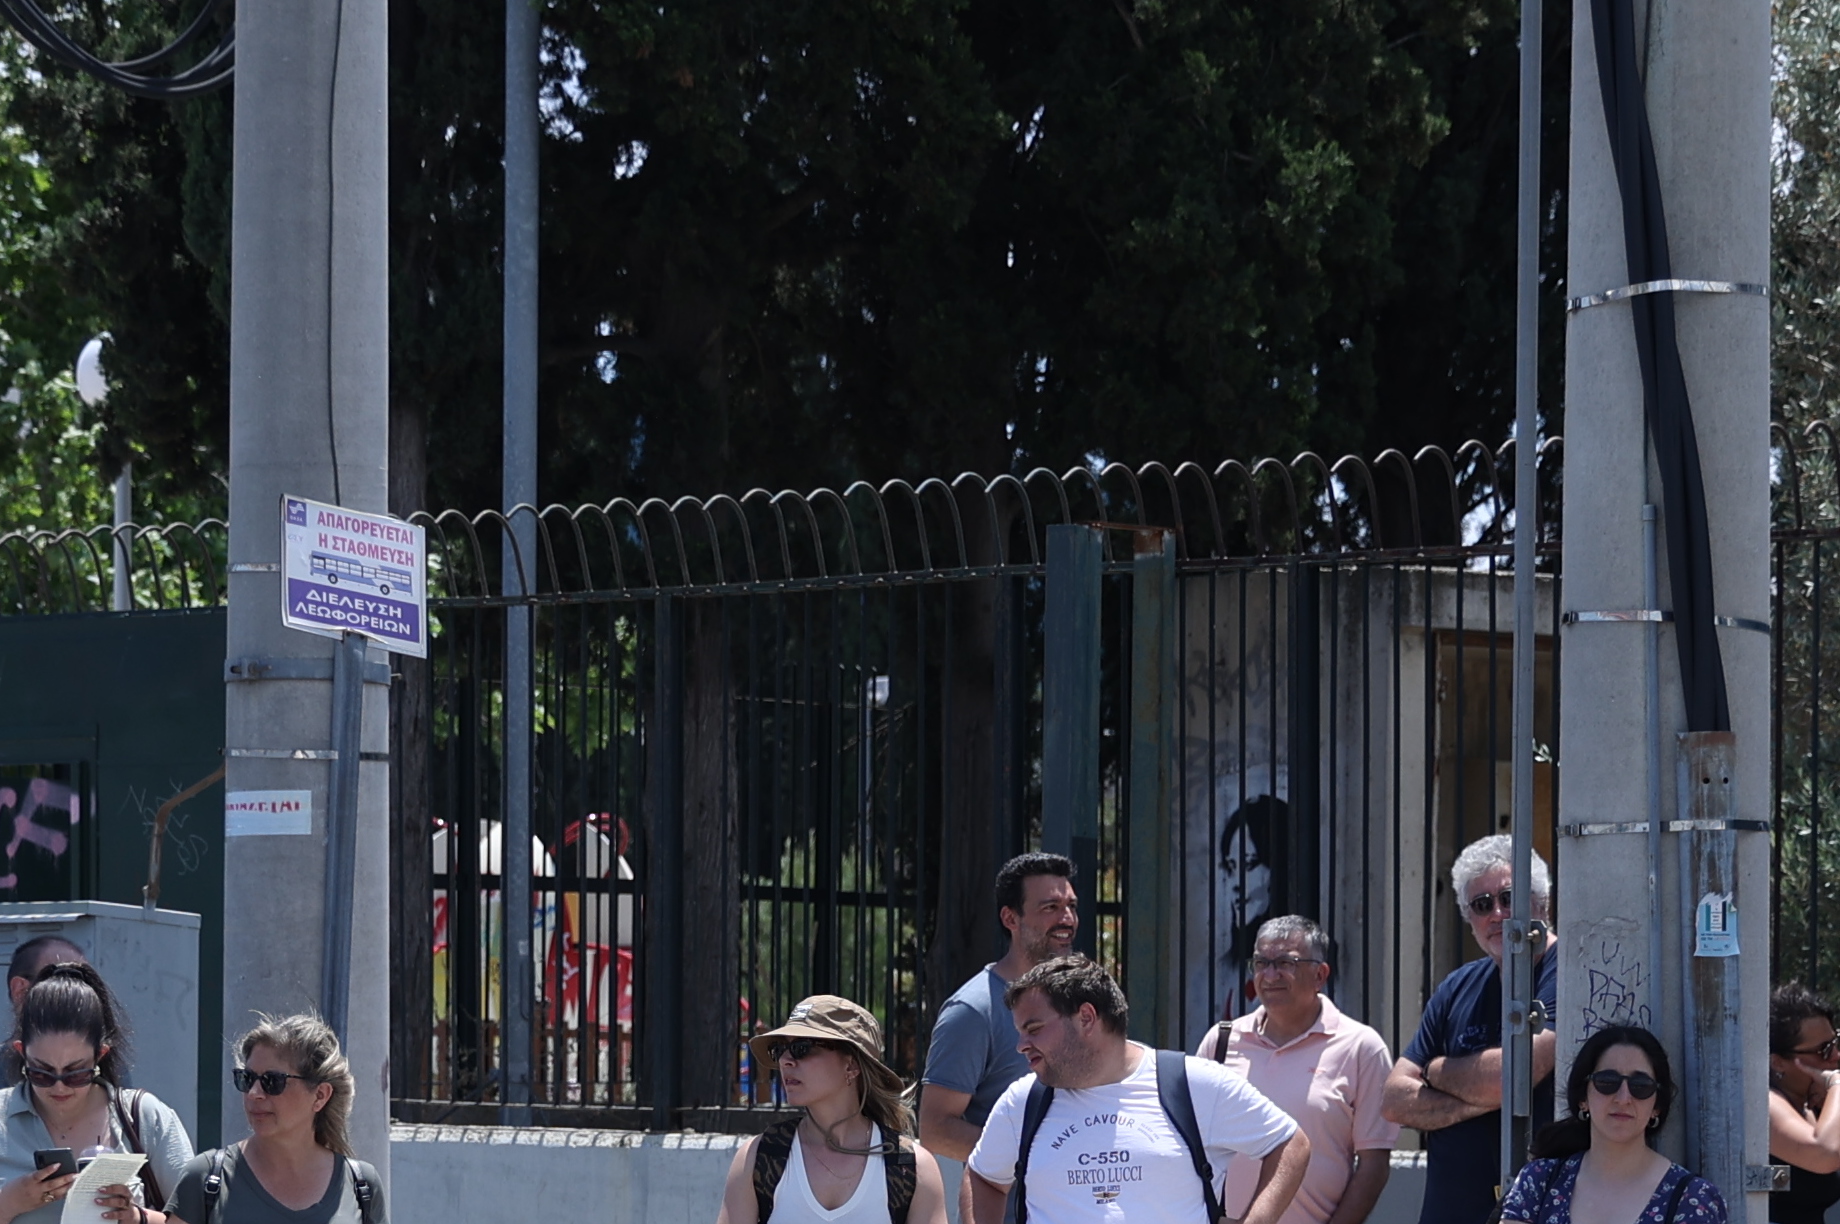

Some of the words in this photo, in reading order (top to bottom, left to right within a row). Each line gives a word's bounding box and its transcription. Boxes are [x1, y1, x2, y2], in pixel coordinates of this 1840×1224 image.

[317, 510, 414, 546] ΑΠΑΓΟΡΕΥΕΤΑΙ
[318, 532, 328, 549] Η
[332, 535, 415, 568] ΣΤΑΘΜΕΥΣΗ
[295, 601, 411, 635] ΛΕΩΦΟΡΕΙΩΝ
[306, 588, 402, 619] ΔΙΕΛΕΥΣΗ
[1051, 1123, 1079, 1150] NAVE
[1084, 1113, 1135, 1129] CAVOUR
[1078, 1149, 1130, 1166] C-550
[1067, 1169, 1105, 1185] BERTO
[1107, 1165, 1143, 1183] LUCCI
